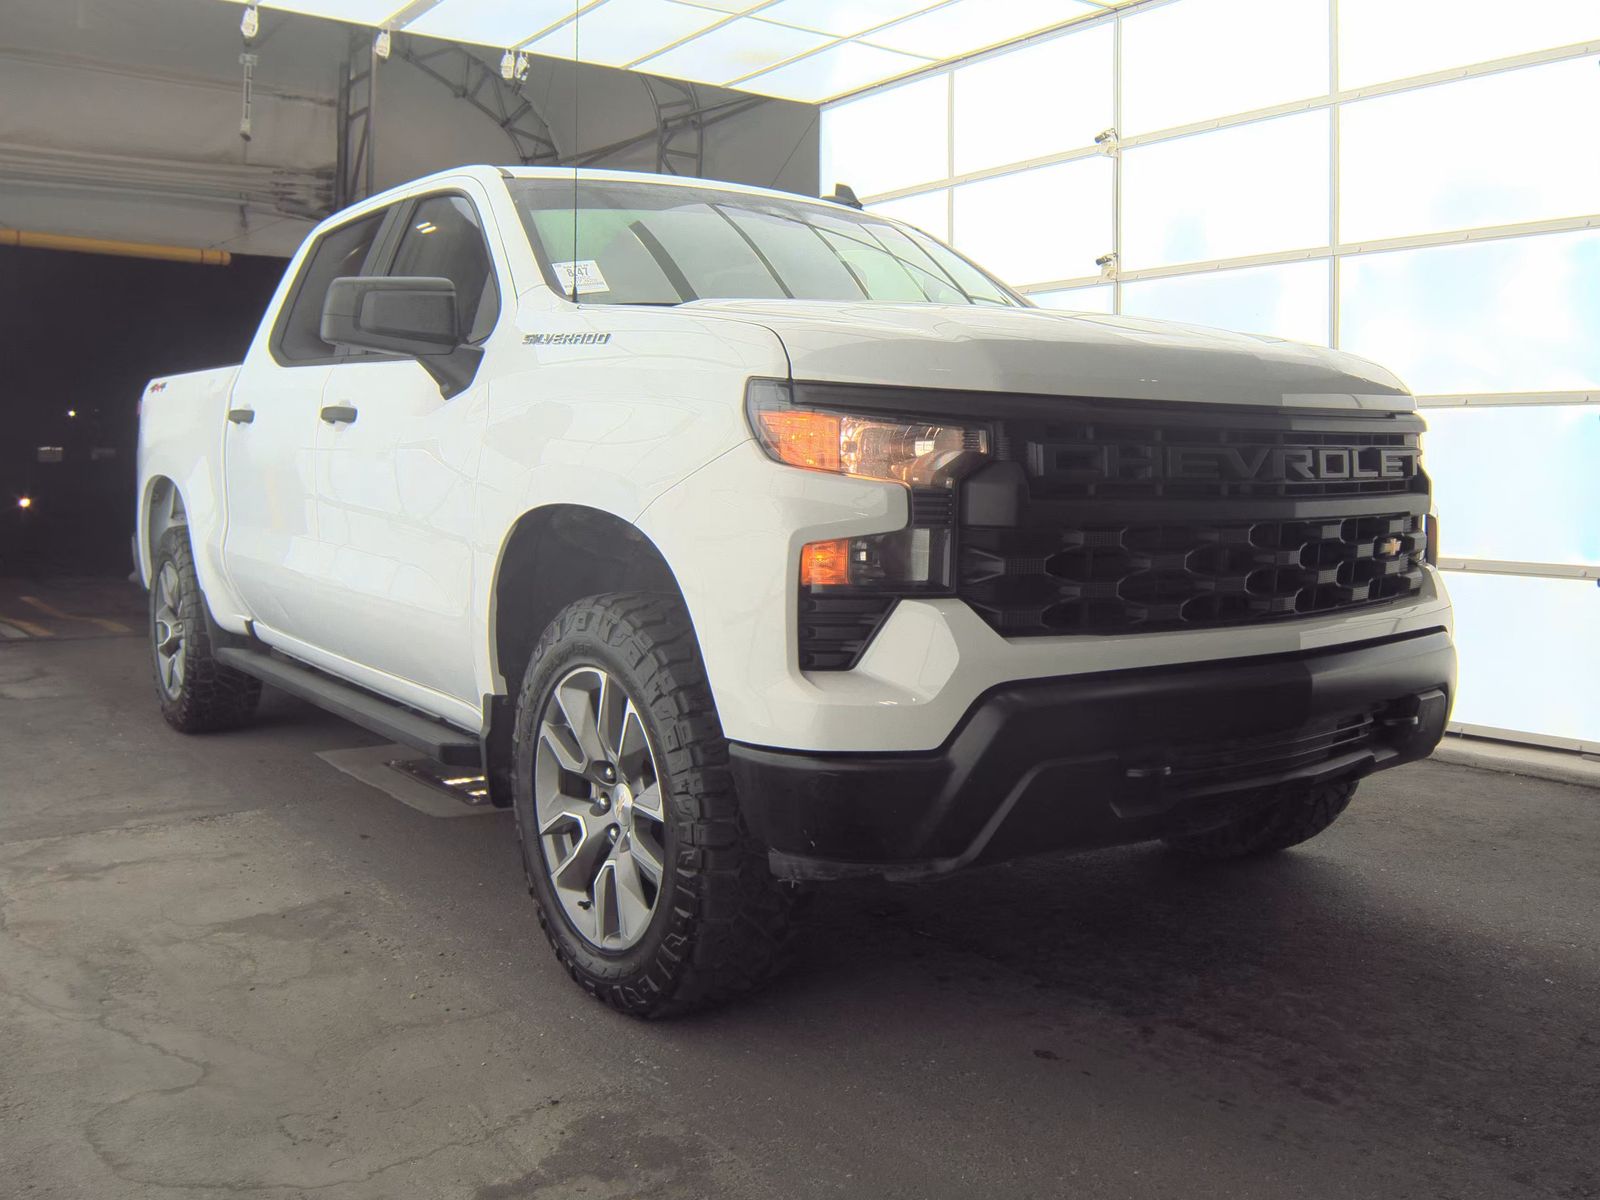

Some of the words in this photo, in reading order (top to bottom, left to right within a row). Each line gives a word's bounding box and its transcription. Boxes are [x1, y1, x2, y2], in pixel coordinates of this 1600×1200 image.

[566, 267, 589, 278] 847
[522, 333, 611, 345] SILVERADO
[1026, 441, 1421, 480] CHEVROLET
